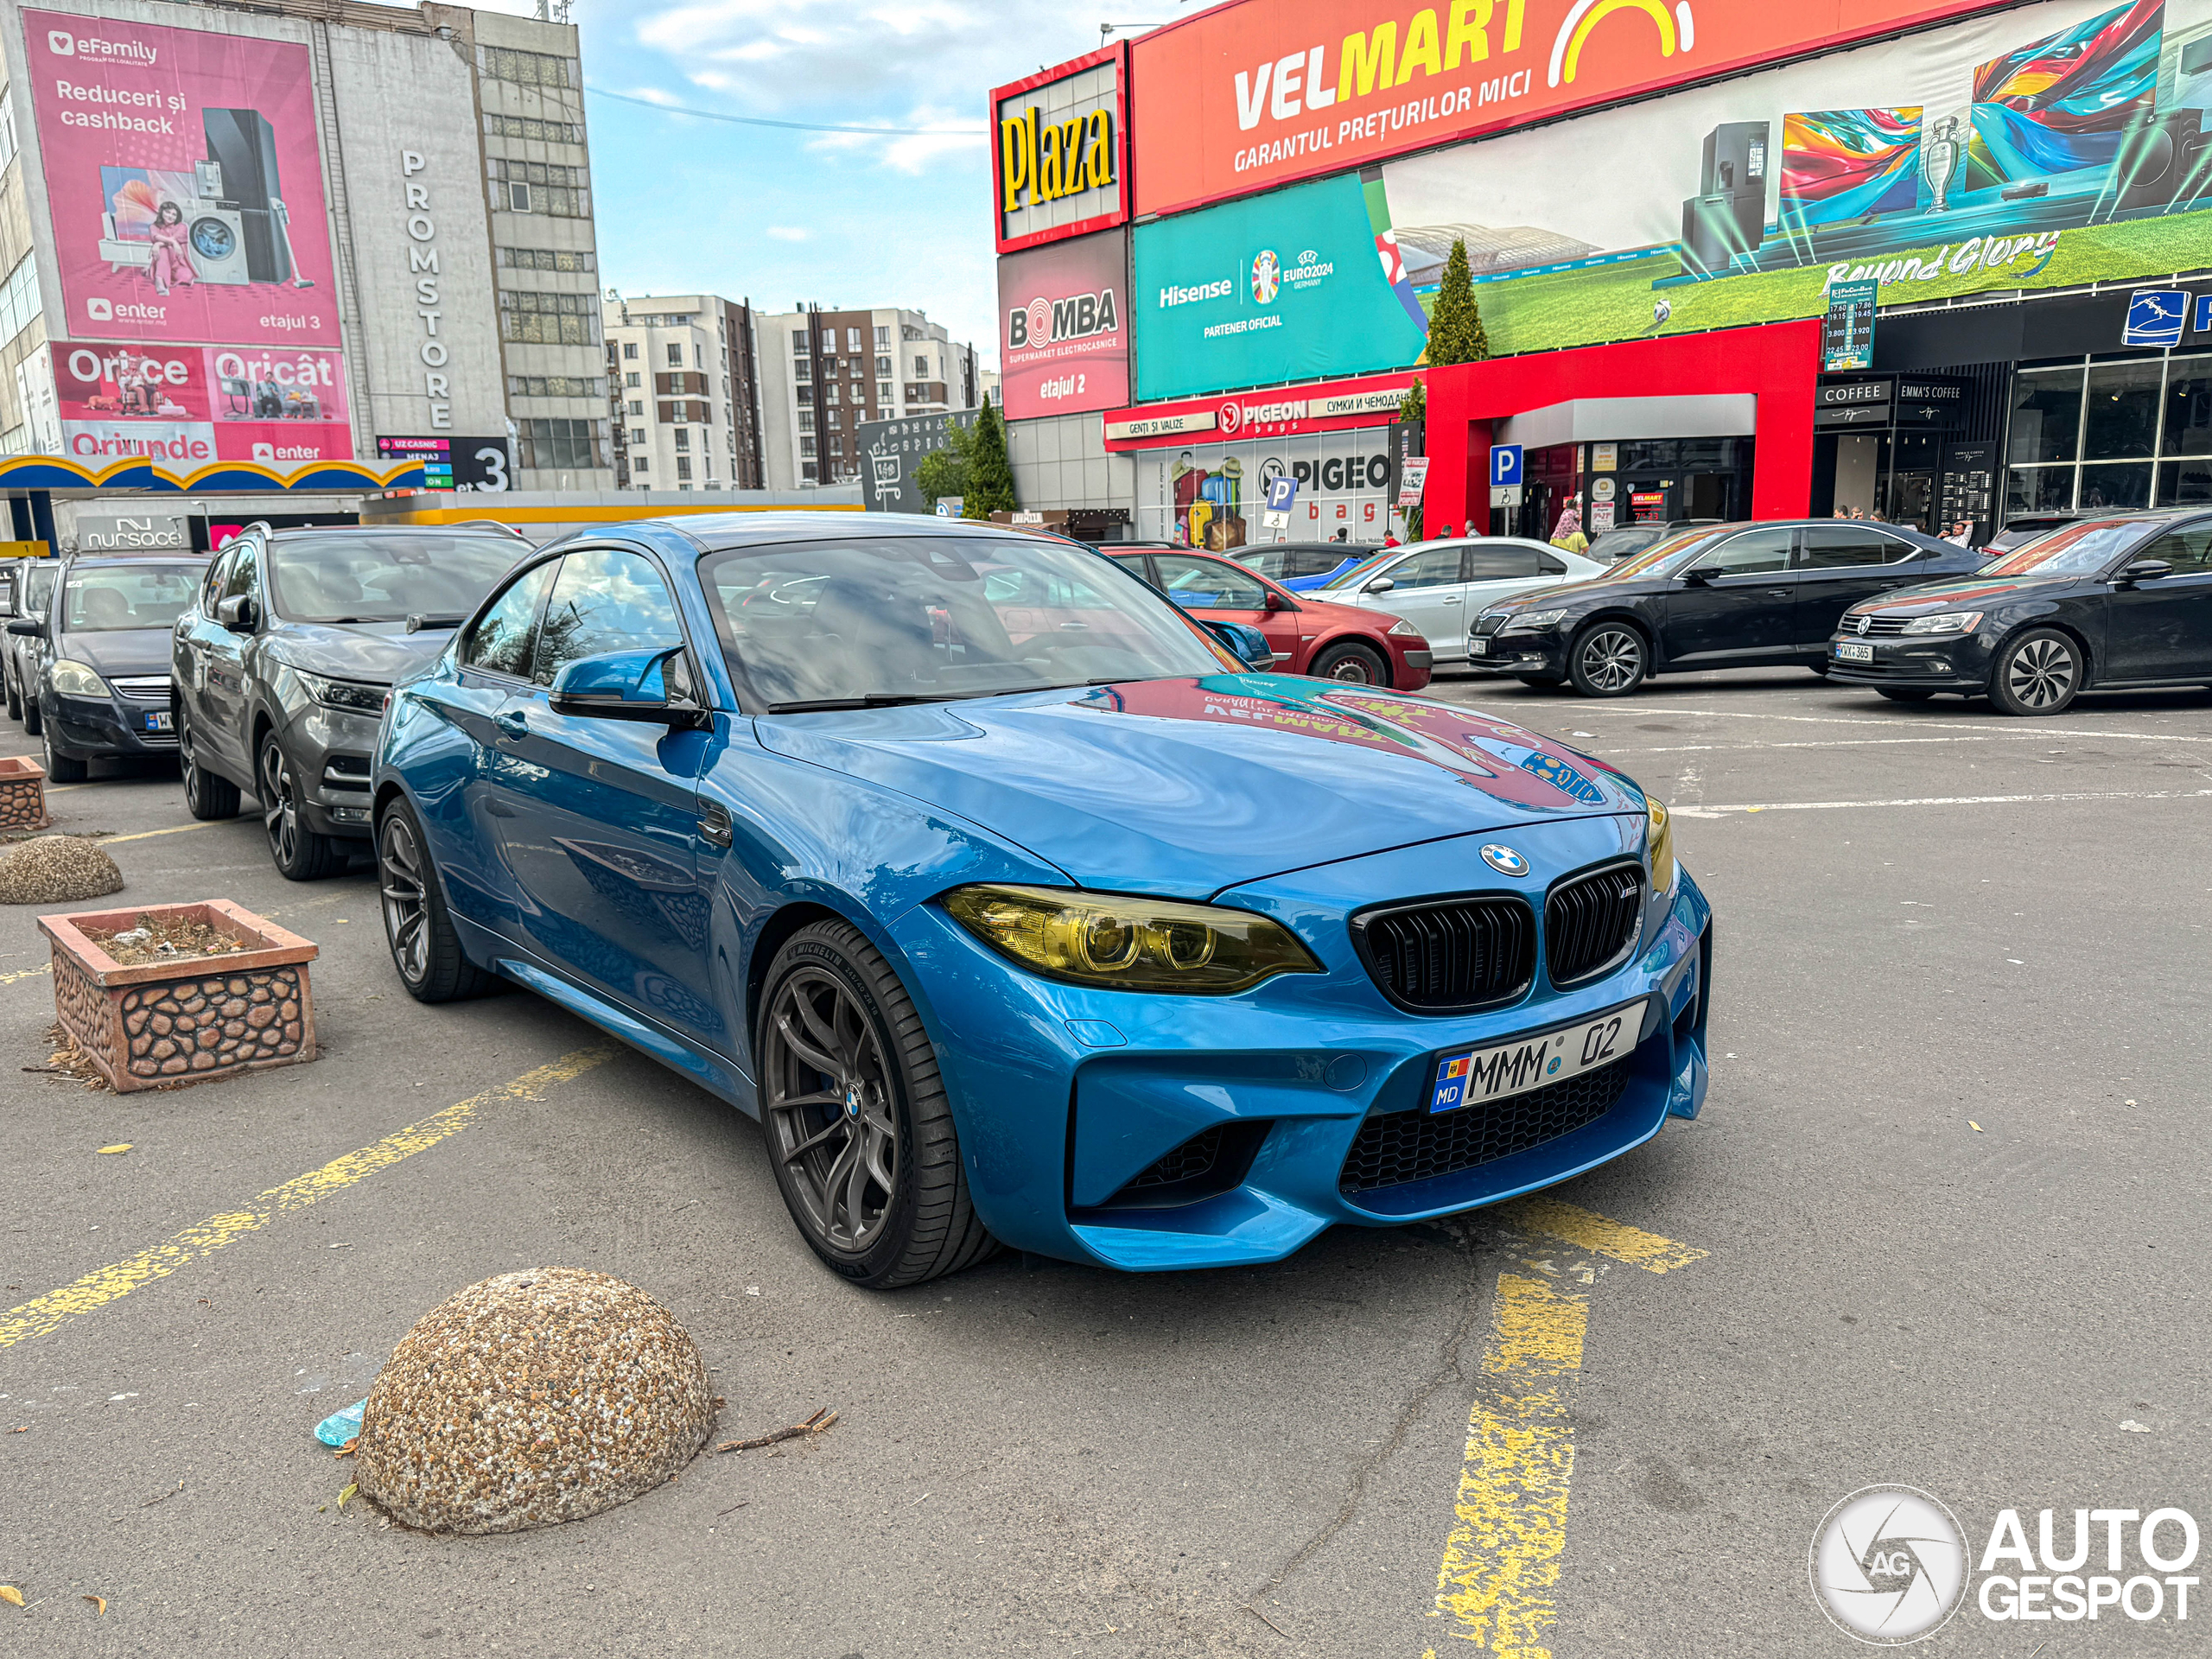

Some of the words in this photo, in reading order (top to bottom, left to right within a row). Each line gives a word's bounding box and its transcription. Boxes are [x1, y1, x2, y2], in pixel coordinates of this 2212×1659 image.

[77, 37, 157, 65] eFamily
[1234, 0, 1525, 130] VELMART
[56, 79, 162, 108] Reduceri
[167, 92, 187, 115] și
[60, 110, 175, 135] cashback
[1235, 129, 1332, 172] GARANTUL
[1478, 68, 1531, 102] MICI
[1001, 105, 1115, 212] Plaza
[1948, 231, 2062, 278] Glory
[1283, 262, 1333, 283] EURO2024
[1294, 277, 1321, 289] GERMANY
[400, 149, 451, 429] PROMSTORE
[1160, 279, 1232, 308] Hisense
[115, 302, 167, 319] enter
[1008, 289, 1118, 350] BOMBA
[1830, 304, 1847, 313] 17.60
[1830, 312, 1847, 321] 19.15
[259, 314, 306, 331] etajul
[309, 315, 321, 329] 3
[1204, 321, 1247, 339] PARTENER
[1249, 315, 1282, 331] OFICIAL
[1853, 327, 1870, 335] 3.920
[1009, 349, 1056, 364] SUPERMARKET
[1058, 338, 1117, 356] ELECTROCASNICE
[1827, 346, 1844, 354] 22.45
[215, 353, 333, 387] Oricât
[1040, 374, 1075, 400] etajul
[1077, 373, 1085, 394] 2
[1825, 385, 1880, 402] COFFEE
[1901, 385, 1929, 397] EMMA'S
[1931, 386, 1961, 399] COFFEE
[1244, 400, 1308, 425] PIGEON
[1327, 398, 1354, 411] СУМКИ
[1356, 397, 1363, 409] И
[1160, 418, 1184, 430] VALIZE
[1255, 422, 1298, 433] bags
[72, 432, 209, 460] Oriunde
[276, 443, 321, 460] enter
[474, 447, 509, 493] 3
[1497, 450, 1516, 481] P
[1273, 481, 1290, 507] P
[88, 531, 182, 548] nursace
[1857, 646, 1869, 658] 365
[797, 944, 842, 966] MICHELIN
[845, 967, 865, 992] 245/40
[864, 994, 873, 1005] ZR
[871, 1006, 879, 1015] 18
[1467, 1040, 1548, 1099] MMM
[1580, 1017, 1622, 1066] 02
[1436, 1085, 1459, 1105] MD
